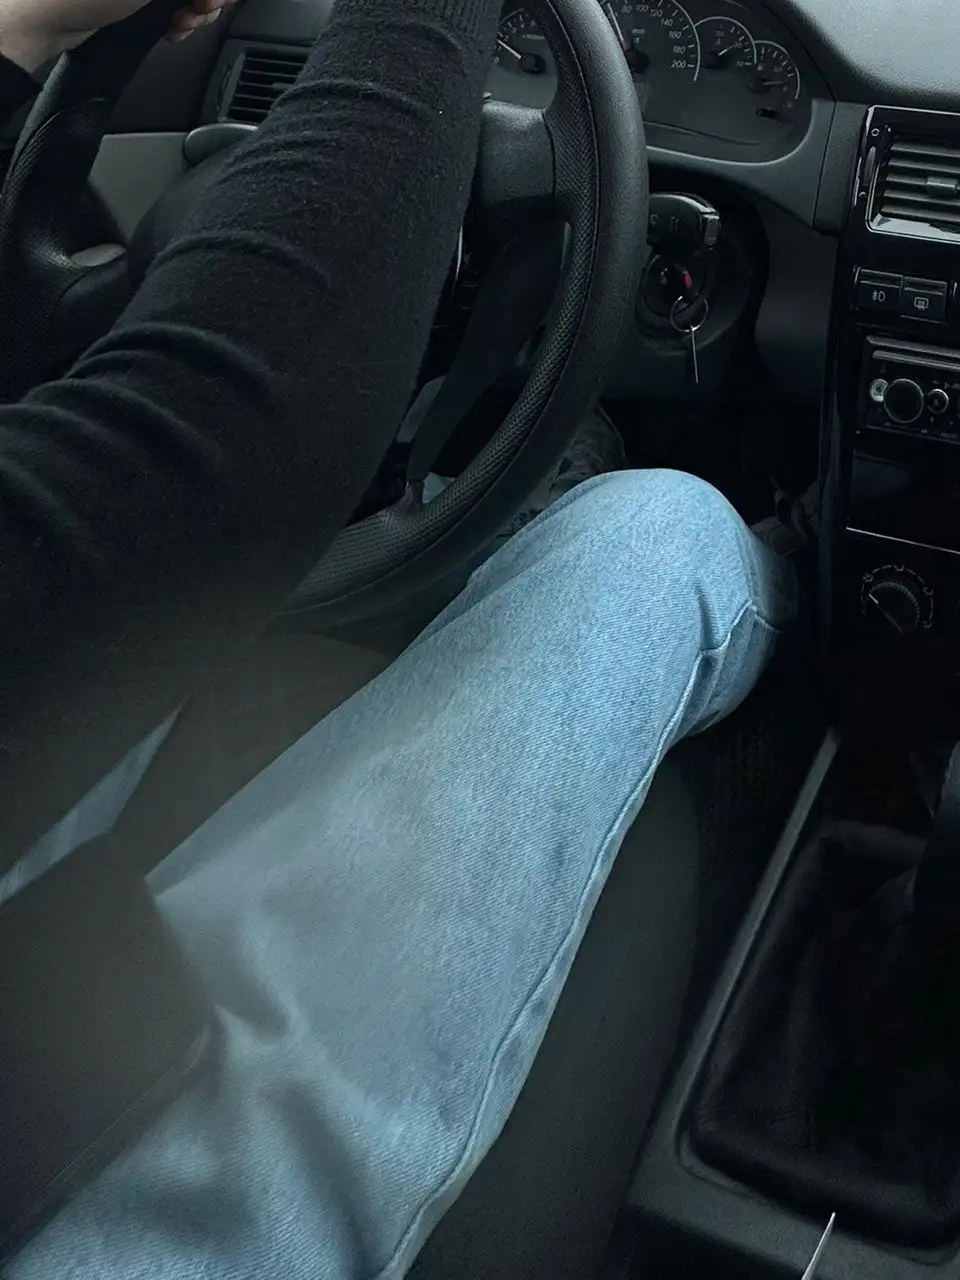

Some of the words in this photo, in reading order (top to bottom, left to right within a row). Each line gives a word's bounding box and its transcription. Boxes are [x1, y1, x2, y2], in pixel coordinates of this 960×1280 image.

[650, 9, 663, 18] 120
[661, 18, 674, 27] 140
[669, 31, 682, 39] 160
[671, 59, 686, 68] 200
